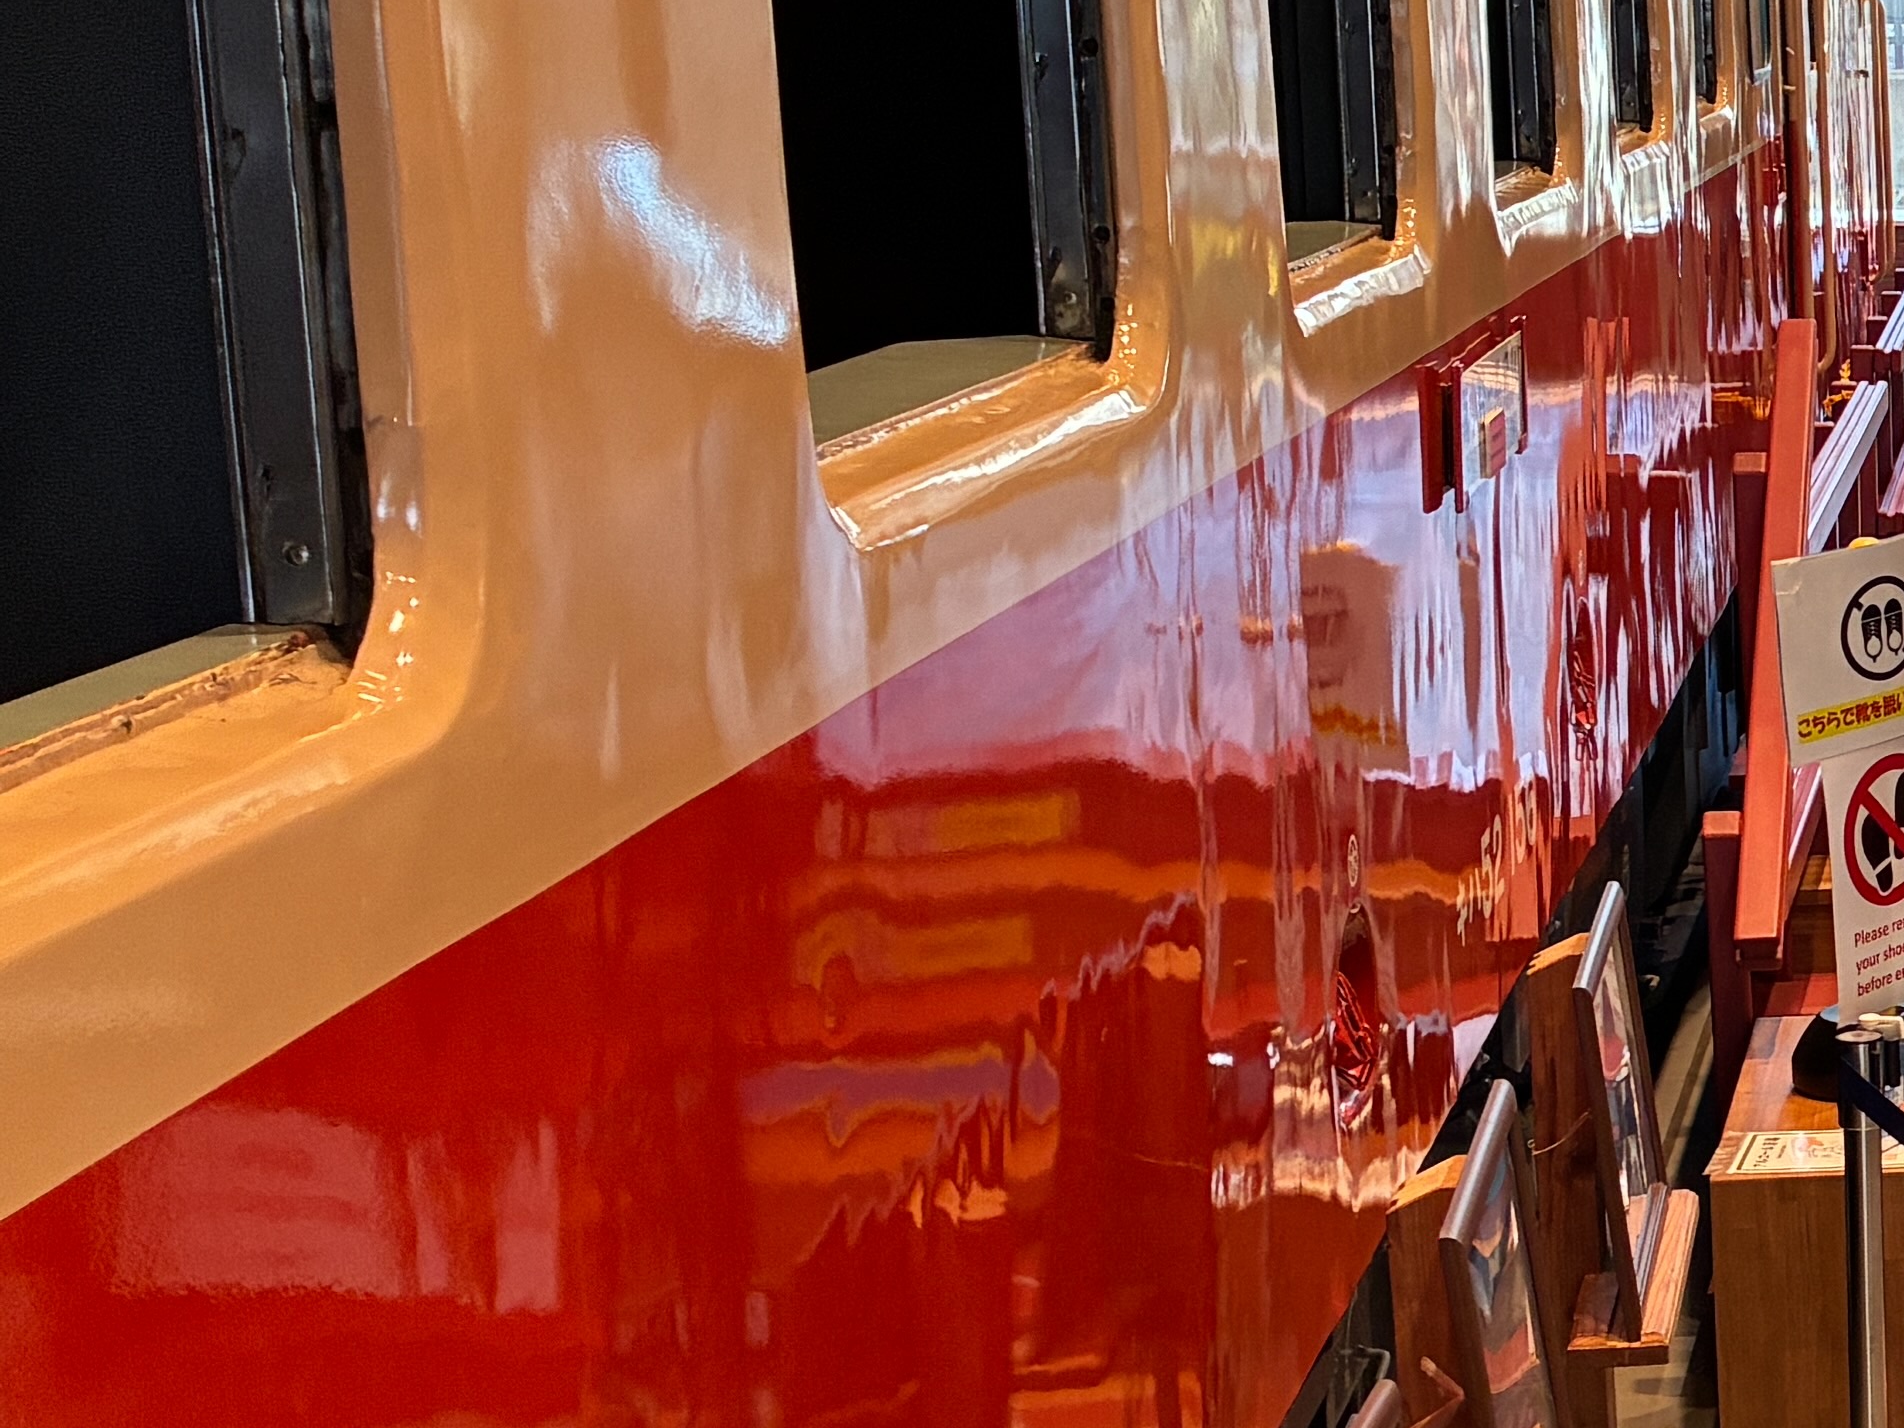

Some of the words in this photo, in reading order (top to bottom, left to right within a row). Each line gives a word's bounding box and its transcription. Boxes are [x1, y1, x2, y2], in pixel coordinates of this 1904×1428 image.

[1853, 923, 1890, 948] Please
[1855, 952, 1881, 975] your
[1857, 972, 1893, 997] before
